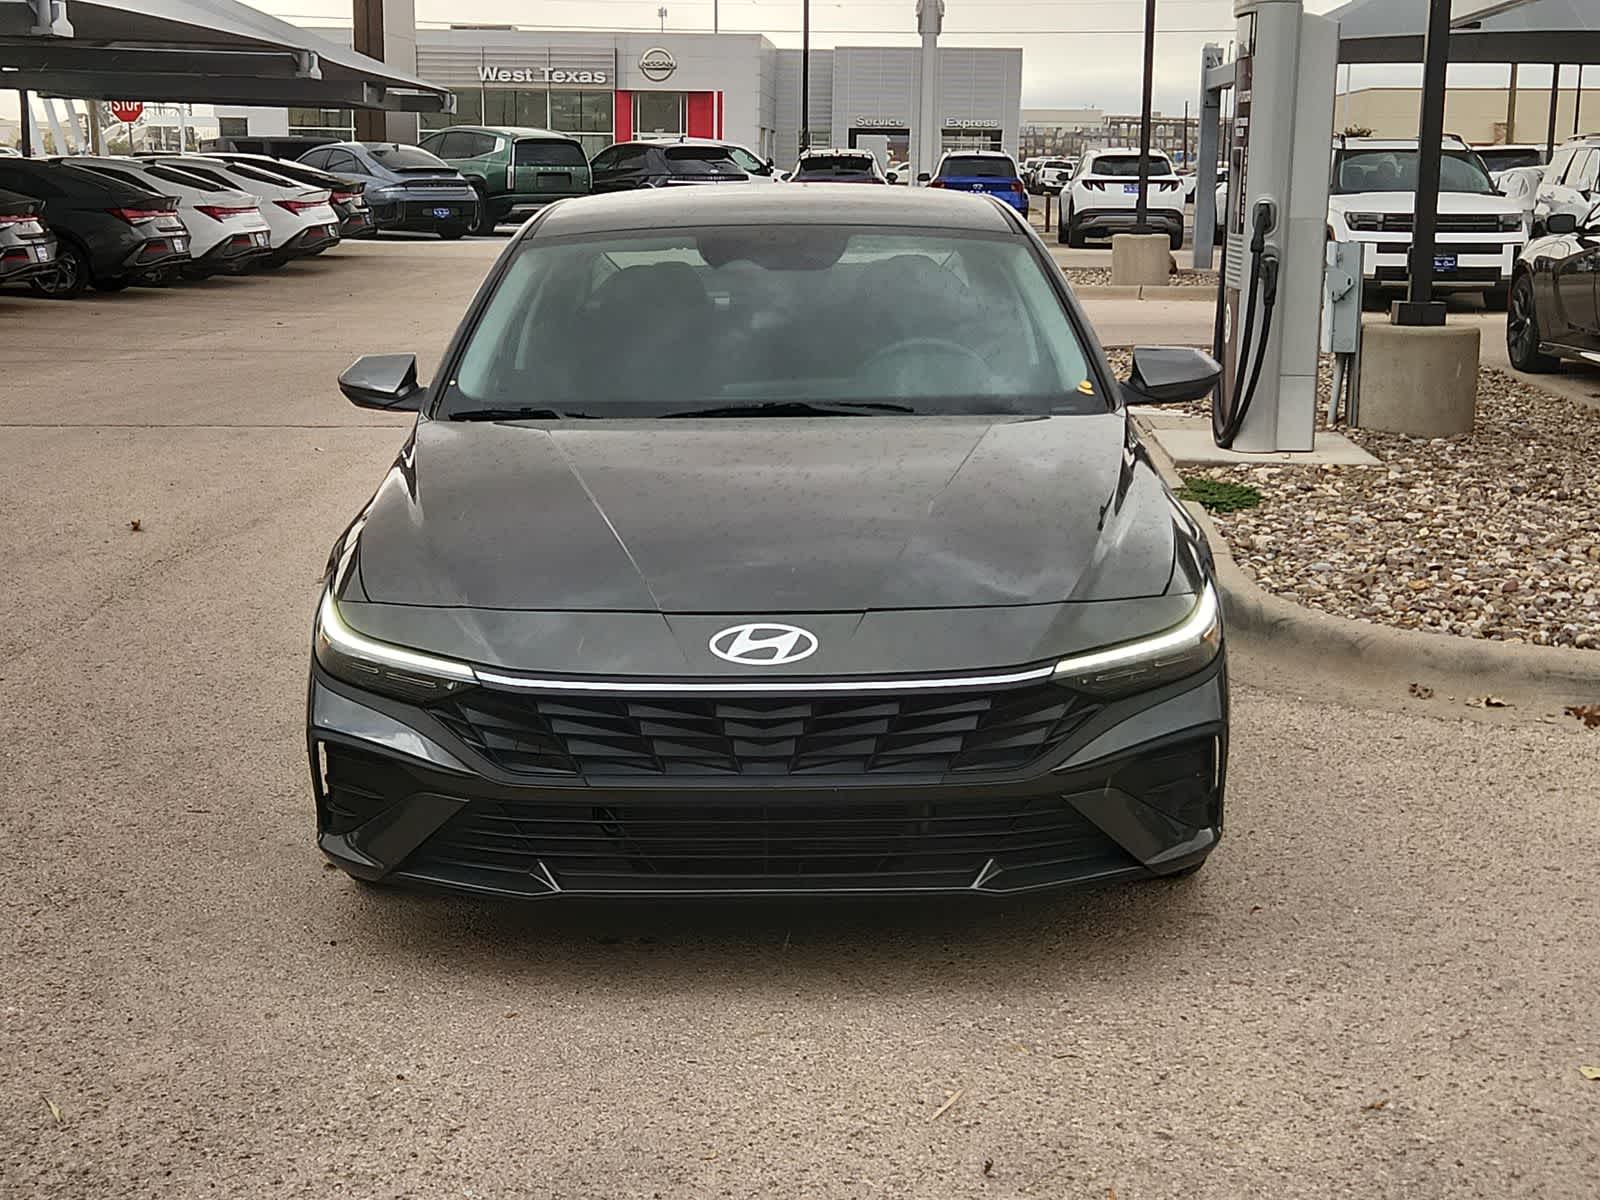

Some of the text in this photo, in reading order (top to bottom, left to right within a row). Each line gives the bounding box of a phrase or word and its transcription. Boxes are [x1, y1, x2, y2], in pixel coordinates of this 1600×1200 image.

[478, 66, 607, 83] West Texas
[856, 115, 904, 127] Service
[945, 117, 999, 129] Express
